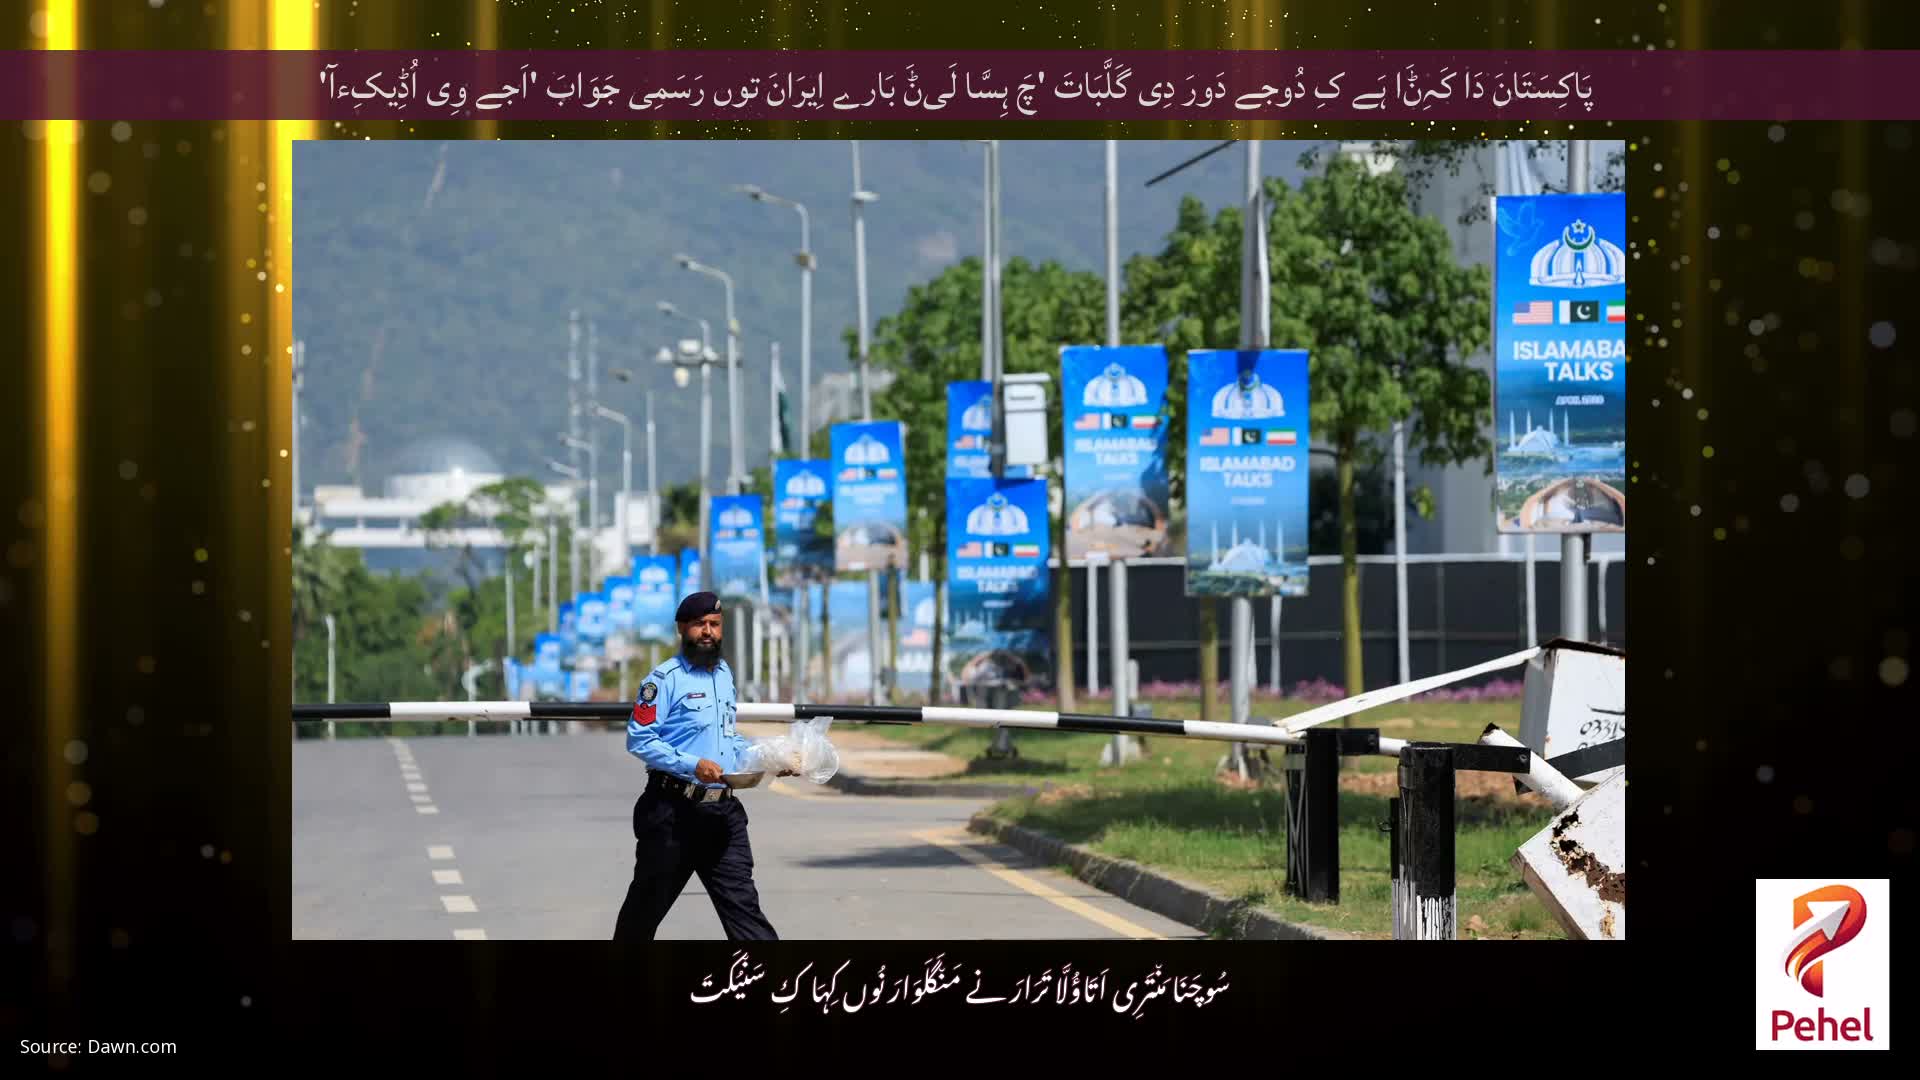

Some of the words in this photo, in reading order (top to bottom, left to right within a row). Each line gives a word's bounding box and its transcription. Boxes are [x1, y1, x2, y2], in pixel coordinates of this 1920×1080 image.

[1544, 361, 1615, 382] TALKS
[1199, 455, 1296, 472] ISLAMABAD
[1223, 471, 1273, 489] TALKS
